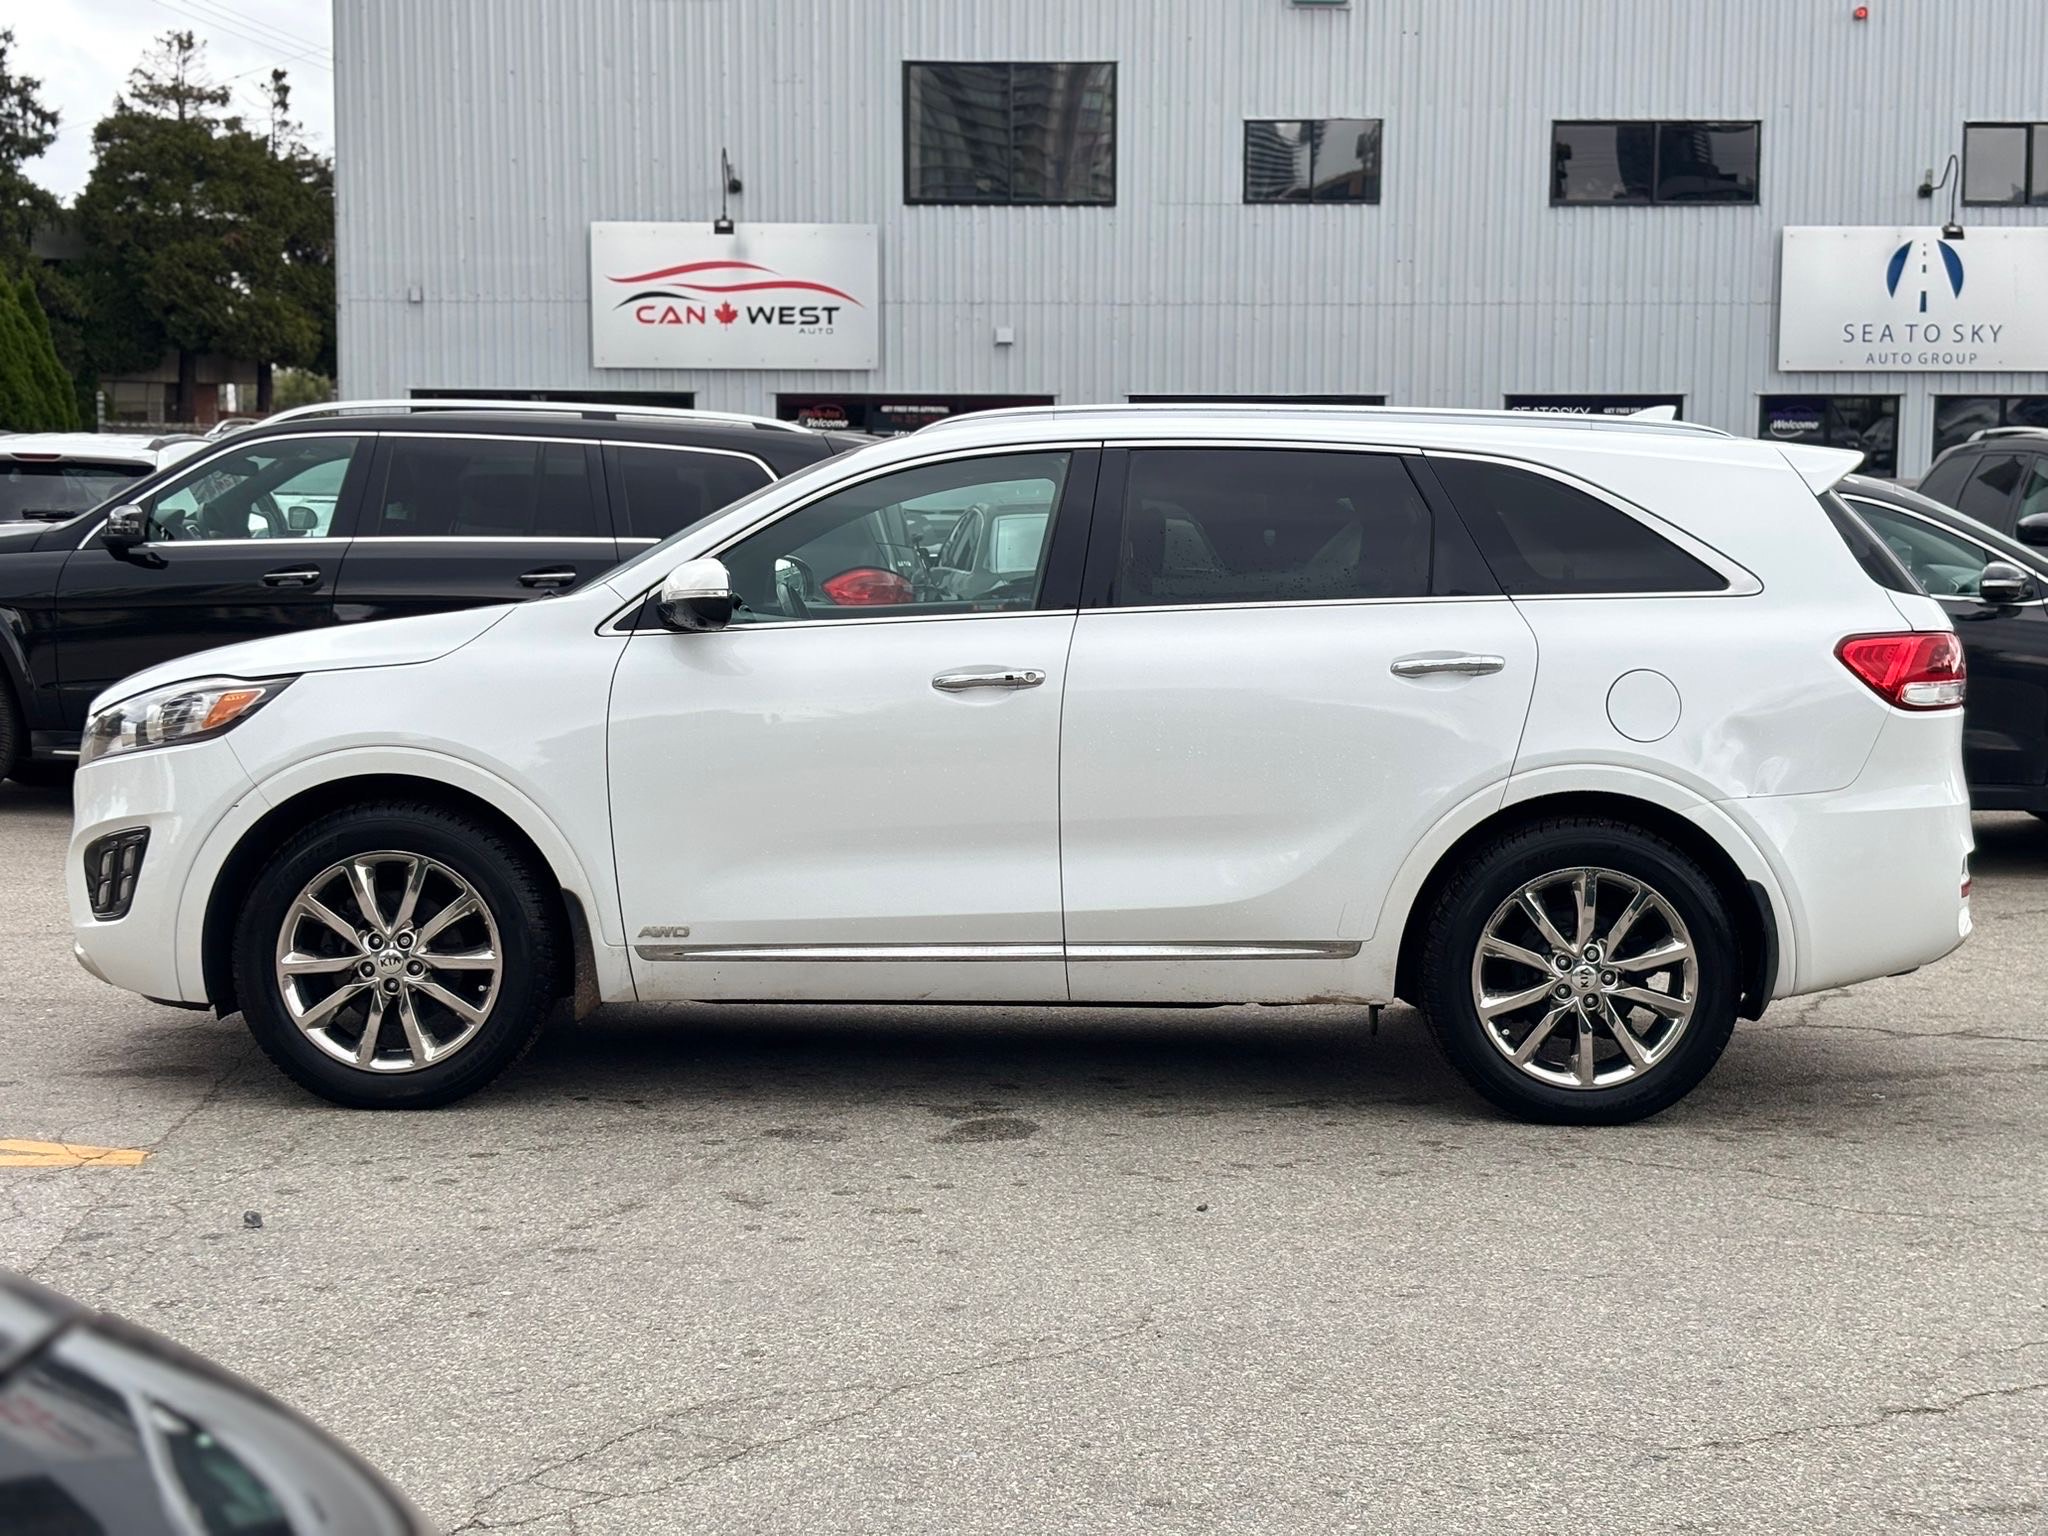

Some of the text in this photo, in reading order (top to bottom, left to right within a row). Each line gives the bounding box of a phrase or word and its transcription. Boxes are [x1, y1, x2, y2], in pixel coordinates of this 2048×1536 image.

[636, 305, 841, 325] CAN WEST
[798, 327, 834, 335] AUTO
[1843, 323, 2003, 343] SEA TO SKY
[1865, 352, 1978, 365] AUTO GROUP
[1773, 420, 1819, 430] Welcome
[638, 926, 690, 938] AWD
[380, 957, 401, 968] KIA
[1580, 967, 1590, 988] KIA
